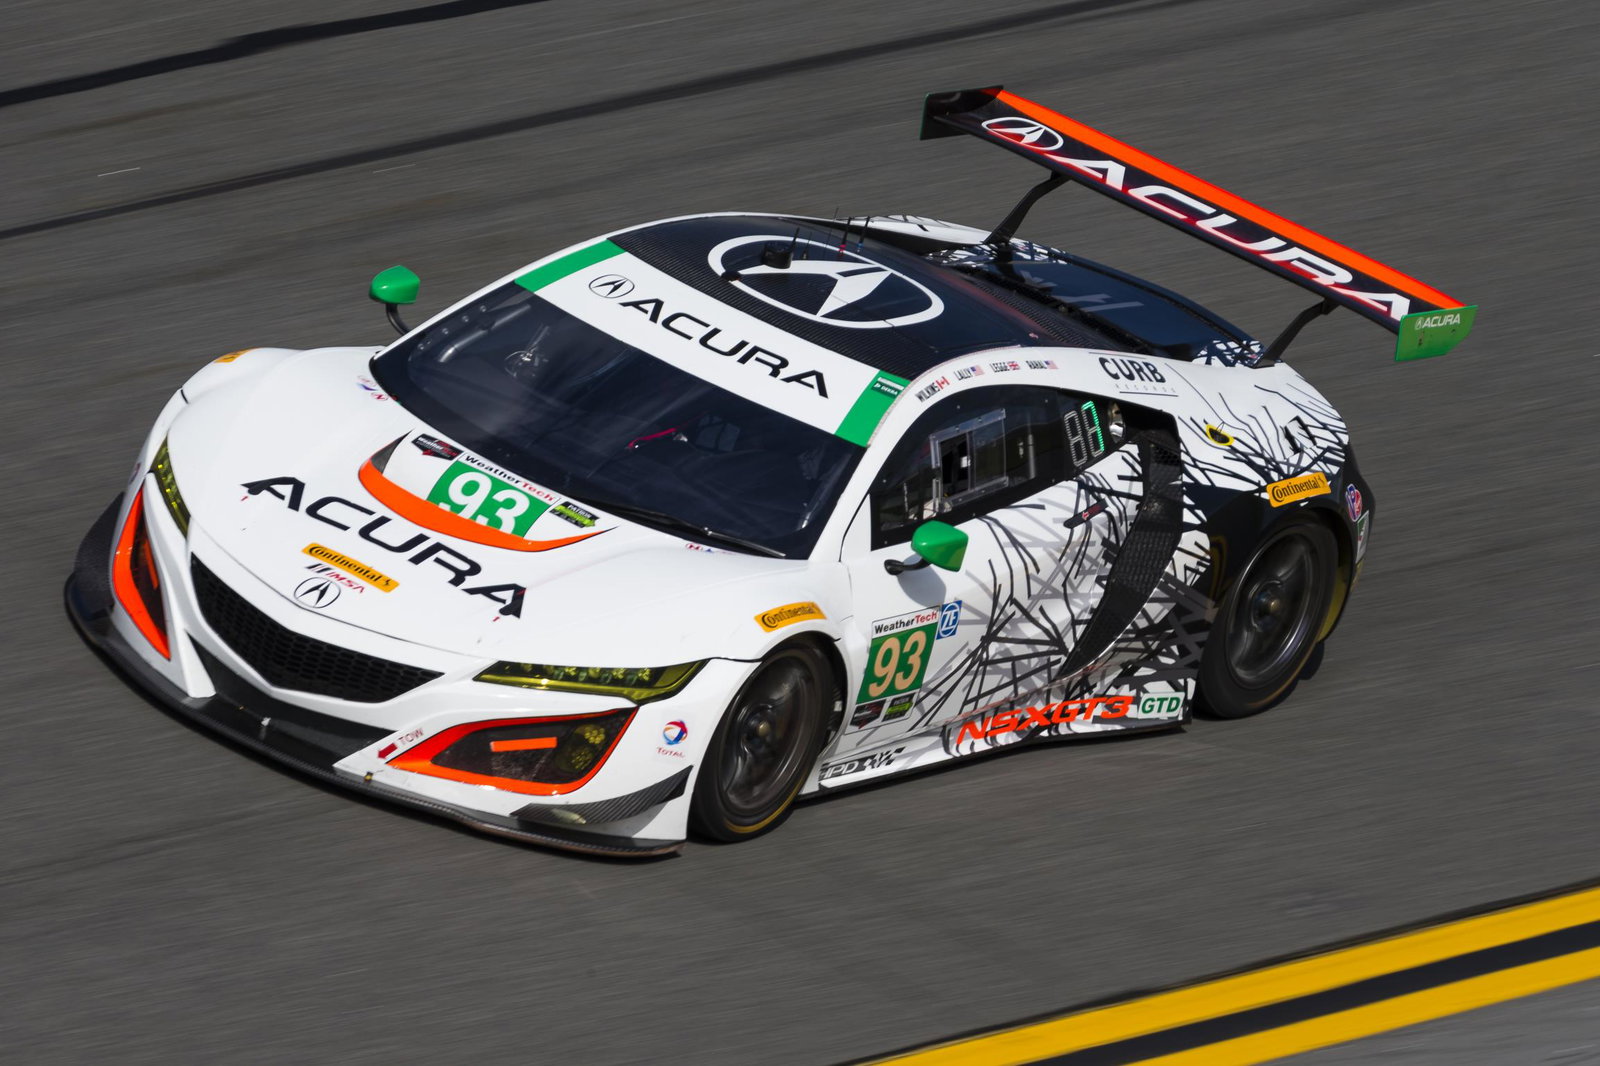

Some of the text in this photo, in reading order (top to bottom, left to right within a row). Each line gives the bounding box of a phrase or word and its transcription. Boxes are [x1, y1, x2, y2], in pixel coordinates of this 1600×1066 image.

[1042, 151, 1411, 321] ACURA
[1422, 313, 1461, 329] ACURA
[618, 298, 829, 399] ACURA
[1098, 356, 1166, 384] CURB
[464, 455, 556, 502] WeatherTech
[1271, 477, 1321, 503] Continental
[438, 472, 531, 538] 93
[240, 476, 526, 620] ACURA
[874, 611, 938, 635] WeatherTech
[941, 609, 959, 631] ZF
[868, 631, 927, 698] 93
[1141, 696, 1181, 715] GTD
[397, 727, 425, 745] TOW
[656, 746, 686, 759] TOTAL
